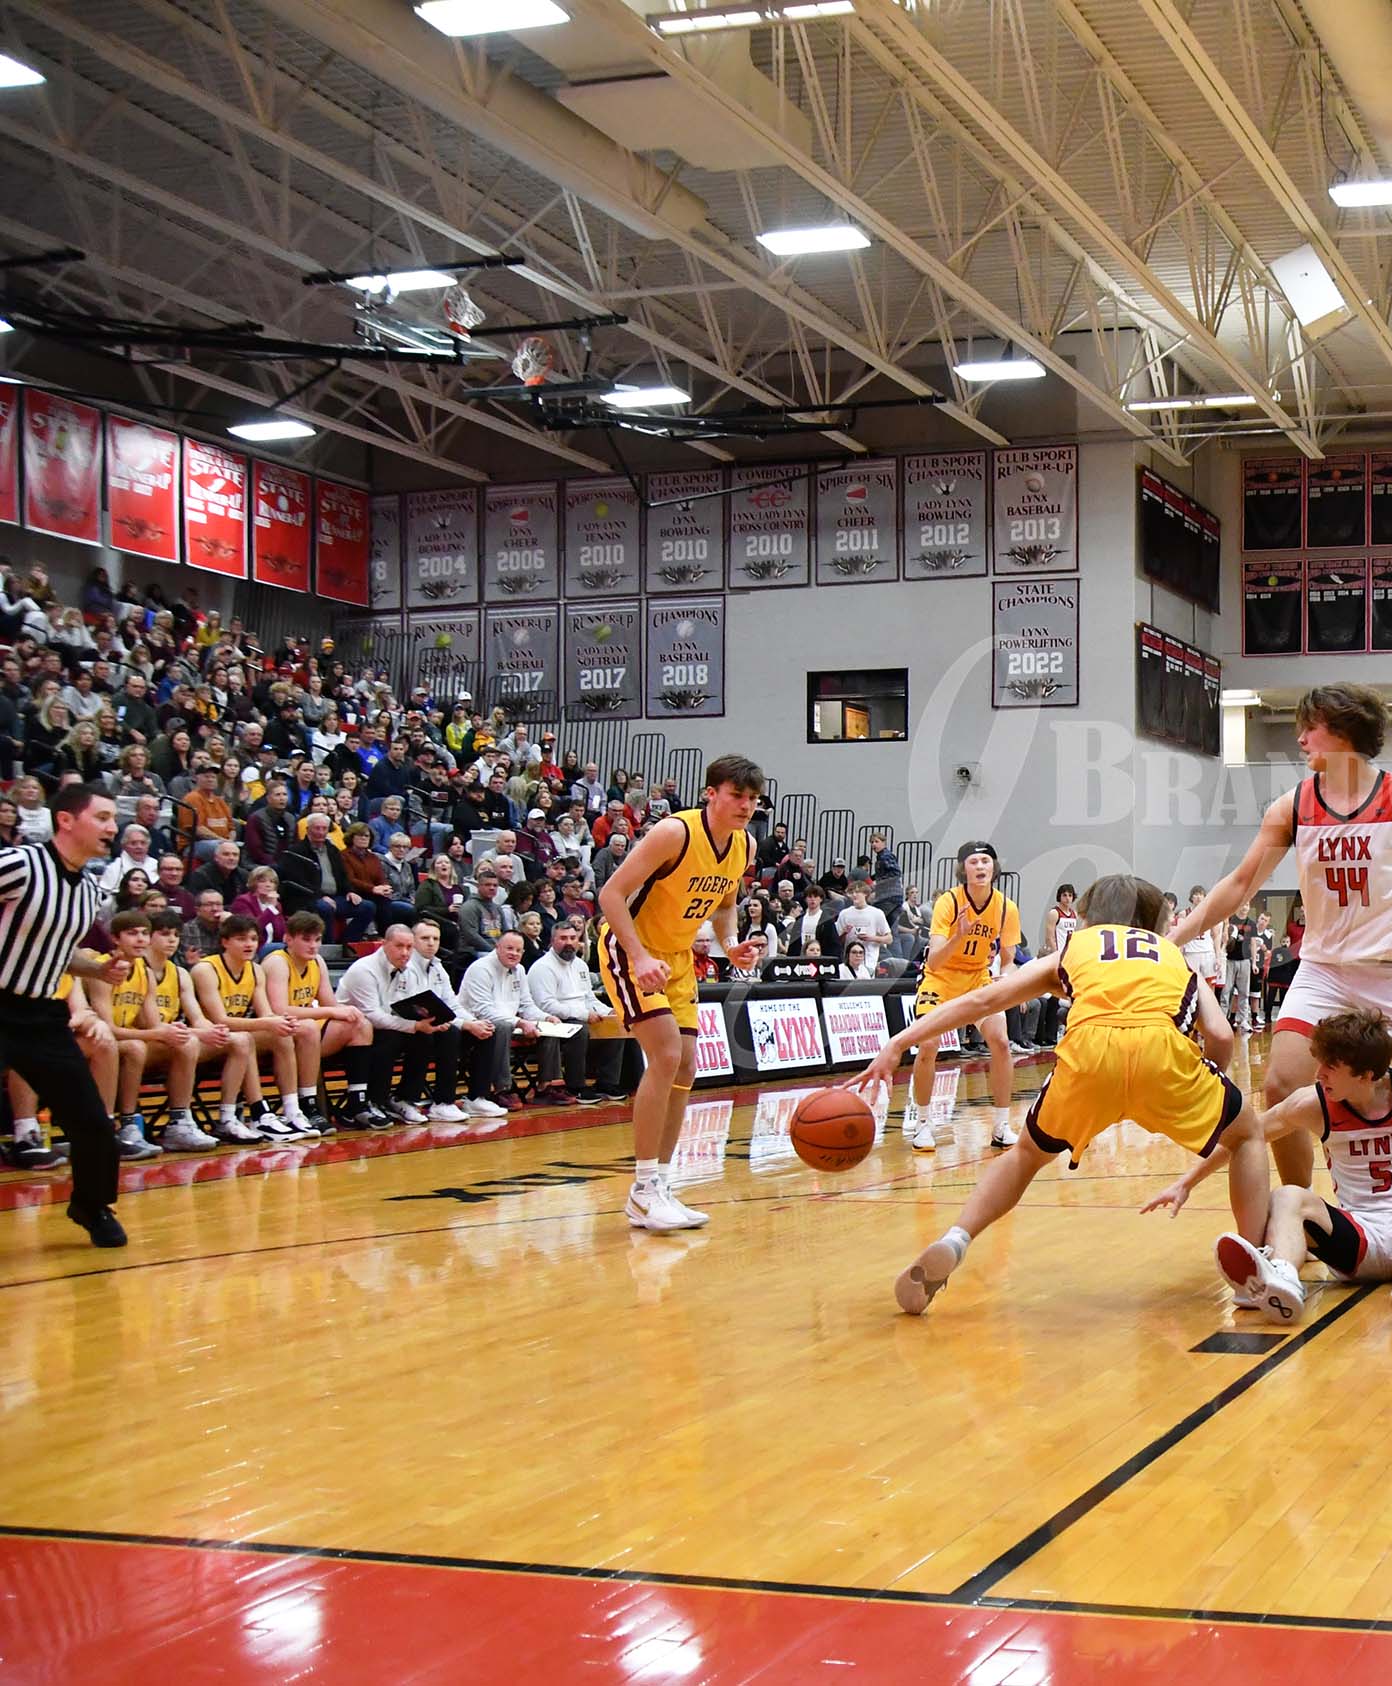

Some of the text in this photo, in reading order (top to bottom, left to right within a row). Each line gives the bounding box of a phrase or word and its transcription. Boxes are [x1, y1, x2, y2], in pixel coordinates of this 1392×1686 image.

[907, 454, 983, 469] CLUB SPORT
[997, 450, 1073, 464] CLUB SPORT
[189, 459, 243, 488] STATE
[737, 469, 801, 481] COMBINED
[908, 468, 982, 485] CHAMPIONS
[997, 463, 1074, 480] RUNNER-UP
[650, 472, 720, 487] CLUB SPORT
[819, 475, 852, 495] SPIRIT
[875, 474, 894, 491] SIX
[258, 481, 305, 507] STATE
[1021, 494, 1048, 504] LYNX
[320, 500, 361, 522] STATE
[844, 505, 869, 516] LYNX
[917, 499, 973, 510] LADY LYNX
[1007, 504, 1064, 516] BASEBALL
[673, 515, 697, 525] LYNX
[784, 509, 806, 519] LYNX
[918, 510, 972, 522] BOWLING
[605, 519, 628, 530] LYNX
[733, 520, 806, 534] CROSS COUNTRY
[837, 517, 875, 528] CHEER
[1010, 518, 1061, 541] 2013
[509, 527, 532, 537] LYNX
[585, 532, 621, 543] TENNIS
[660, 527, 710, 538] BOWLING
[836, 528, 879, 551] 2011
[920, 523, 969, 547] 2012
[418, 543, 465, 554] BOWLING
[504, 537, 538, 548] CHEER
[662, 539, 708, 561] 2010
[746, 534, 793, 557] 2010
[497, 549, 545, 572] 2006
[580, 544, 625, 566] 2010
[418, 555, 467, 577] 2004
[1016, 584, 1054, 595] STATE
[998, 596, 1074, 611] CHAMPIONS
[572, 613, 634, 633] RUNNER-UP
[653, 609, 719, 628] CHAMPIONS
[414, 623, 473, 642] RUNNER-UP
[492, 618, 552, 637] RUNNER-UP
[1021, 627, 1049, 637] LYNX
[576, 645, 629, 657] LADY LYNX
[672, 641, 697, 651] LYNX
[999, 637, 1073, 650] POWERLIFTING
[509, 649, 535, 658] LYNX
[577, 655, 628, 666] SOFTBALL
[659, 652, 711, 663] BASEBALL
[497, 659, 545, 670] BASEBALL
[1008, 652, 1064, 674] 2022
[579, 667, 627, 690] 2017
[662, 664, 708, 687] 2018
[1318, 835, 1372, 862] LYNX
[1325, 867, 1370, 907] 44
[683, 898, 713, 920] 23
[963, 940, 978, 956] 11
[1100, 929, 1159, 962] 12
[760, 1004, 777, 1013] HOME
[788, 1003, 801, 1011] THE
[829, 1011, 886, 1034] BRANDON VALLEY
[774, 1015, 822, 1061] LYNX
[839, 1034, 882, 1057] HIGH SCHOOL
[1369, 1160, 1392, 1194] 5
